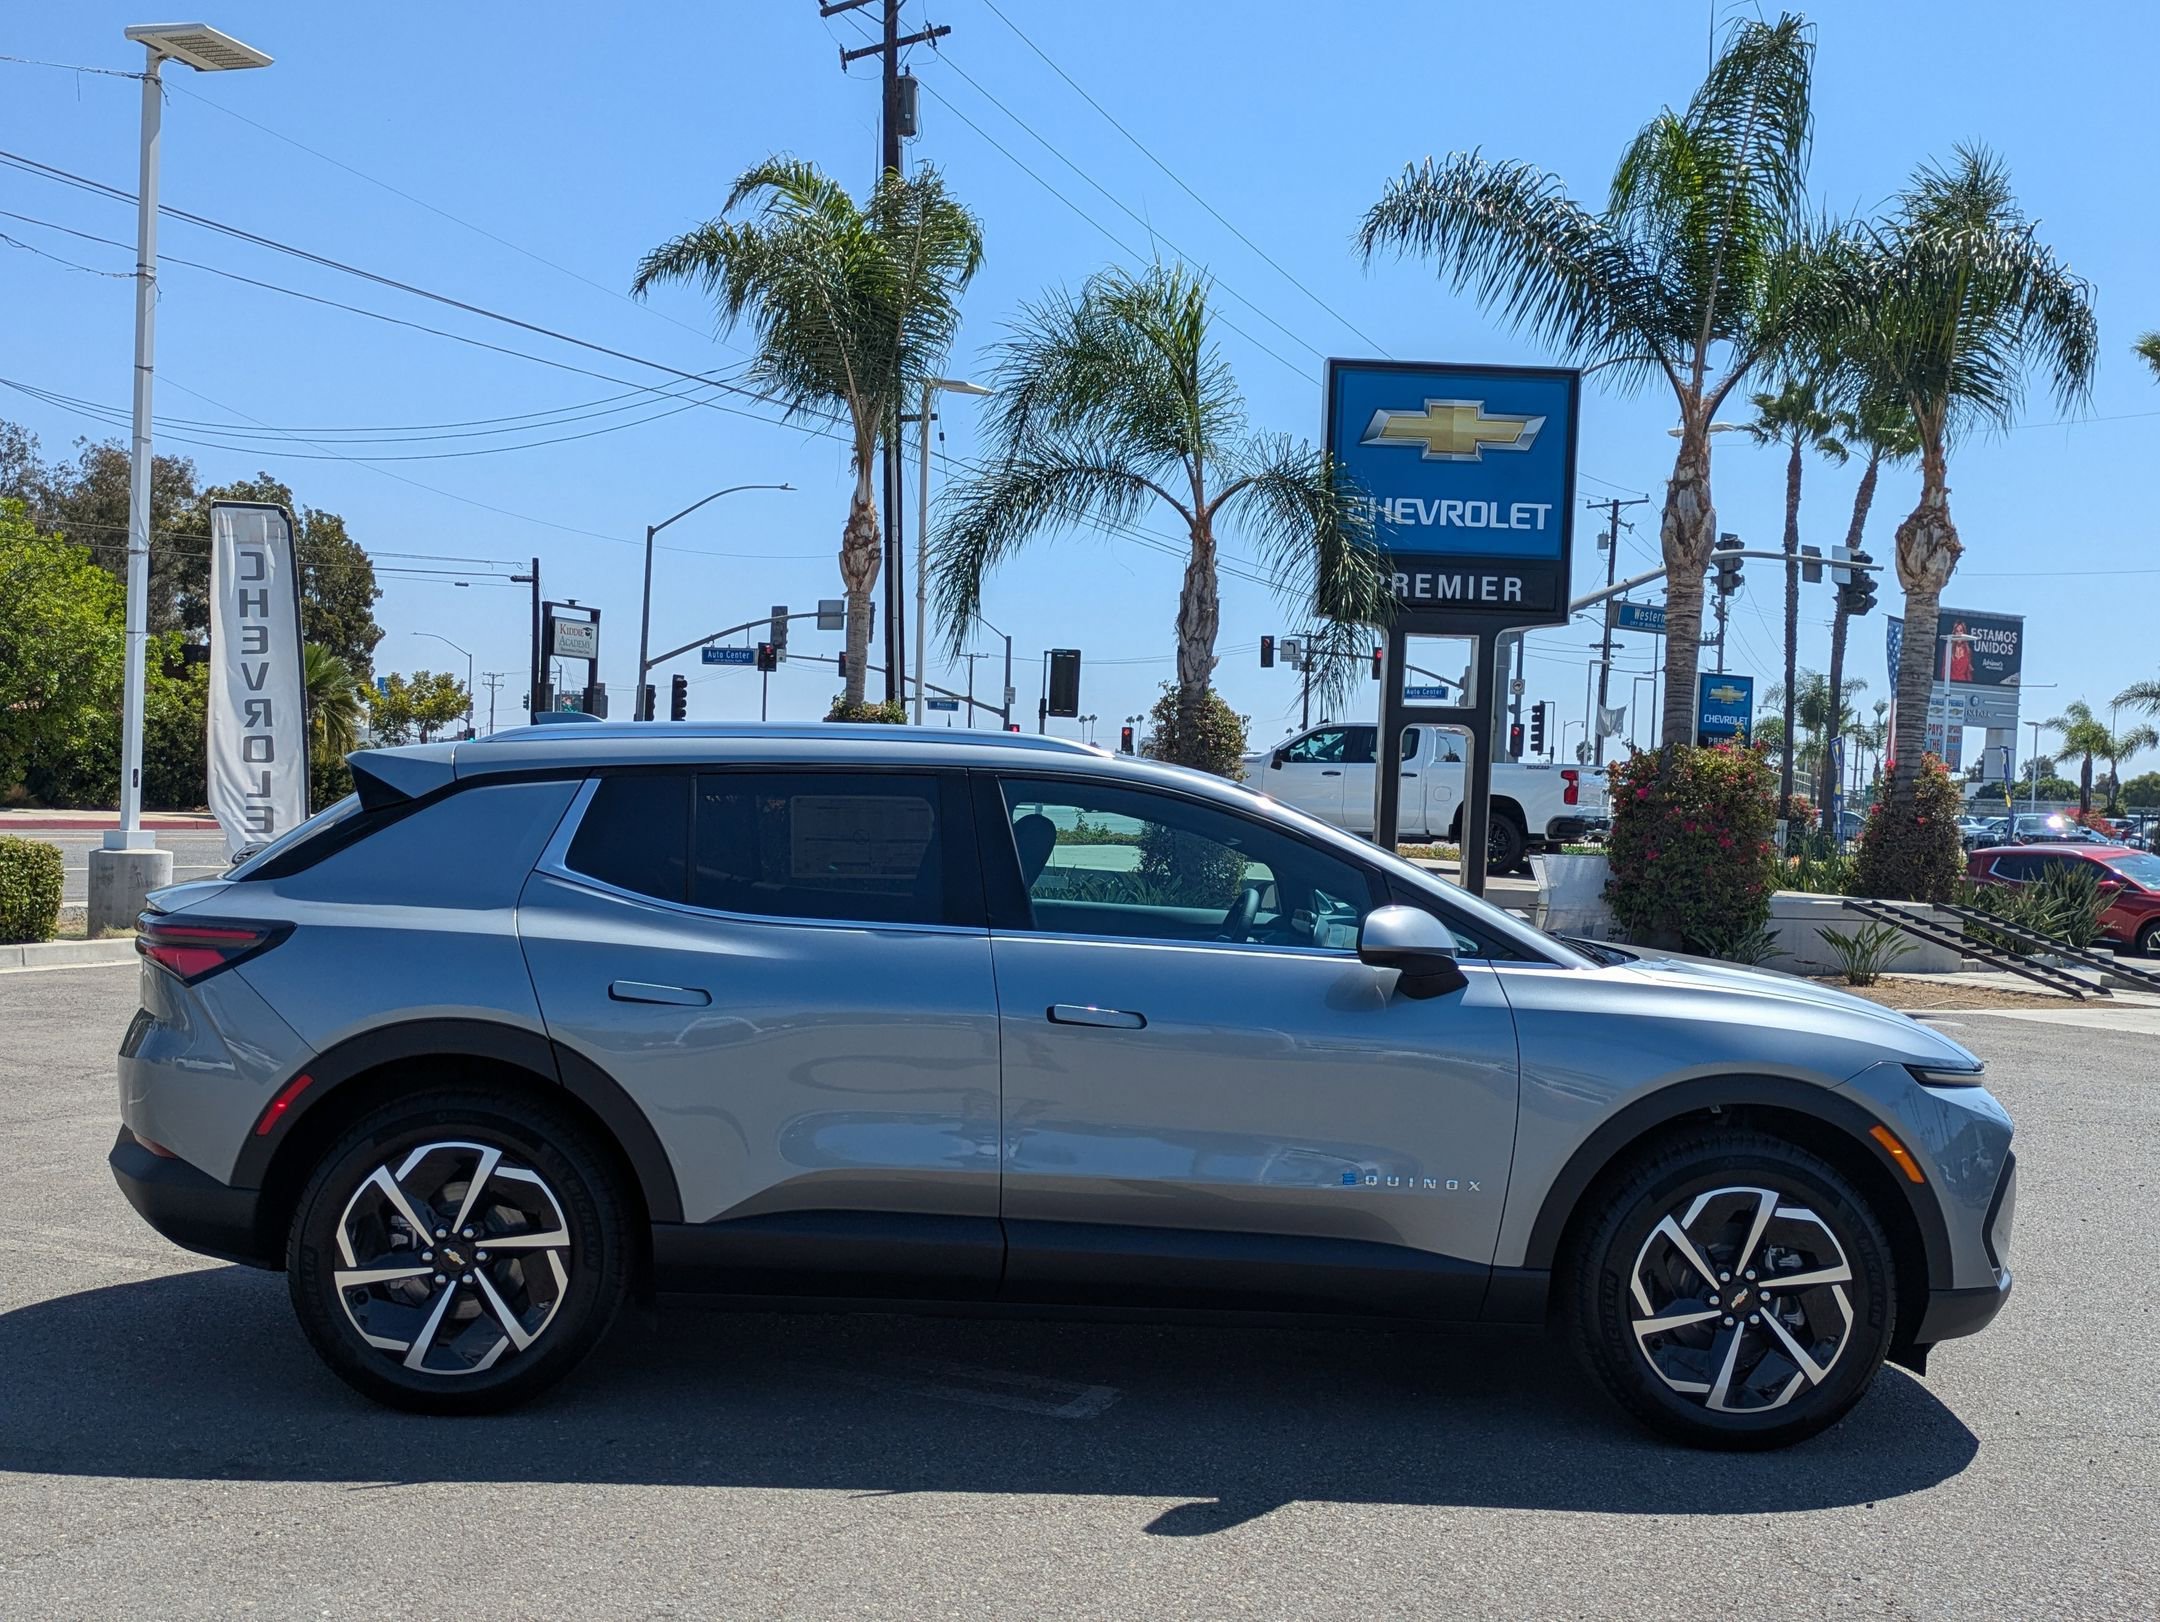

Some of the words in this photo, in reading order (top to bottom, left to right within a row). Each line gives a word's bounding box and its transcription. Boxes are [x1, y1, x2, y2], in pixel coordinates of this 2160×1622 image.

[1634, 608, 1666, 623] Western
[1971, 628, 2018, 644] ESTAMOS
[707, 650, 724, 659] Auto
[726, 651, 750, 660] Center
[1974, 640, 2014, 655] UNIDOS
[1704, 714, 1749, 726] CHEVROLET
[1342, 1172, 1481, 1192] EQUINOX
